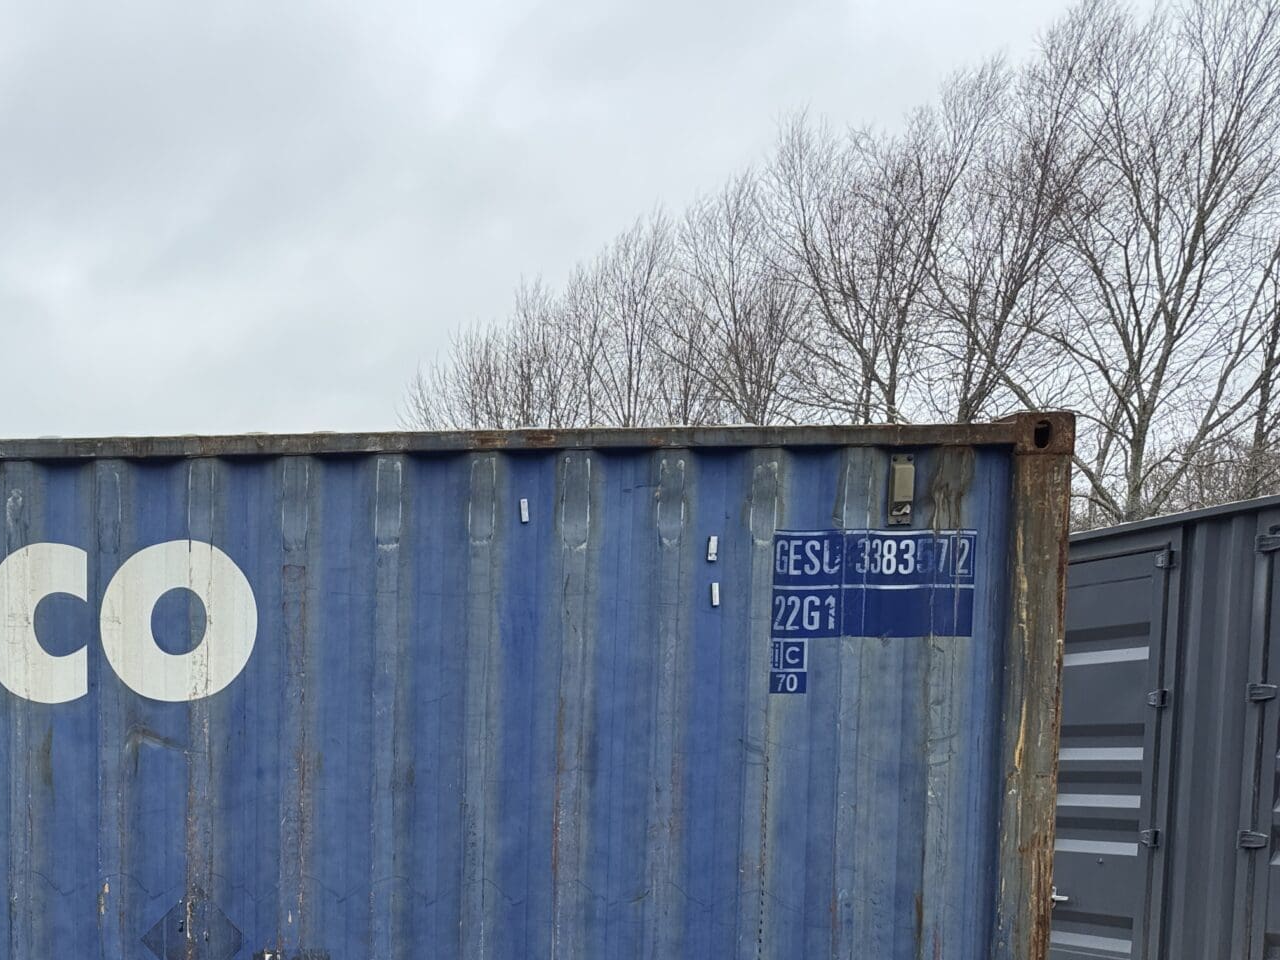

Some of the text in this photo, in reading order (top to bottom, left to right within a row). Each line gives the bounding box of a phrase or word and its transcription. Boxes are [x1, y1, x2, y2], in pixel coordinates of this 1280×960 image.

[775, 539, 841, 576] GESU
[773, 595, 836, 631] 22G1
[775, 673, 799, 693] 70
